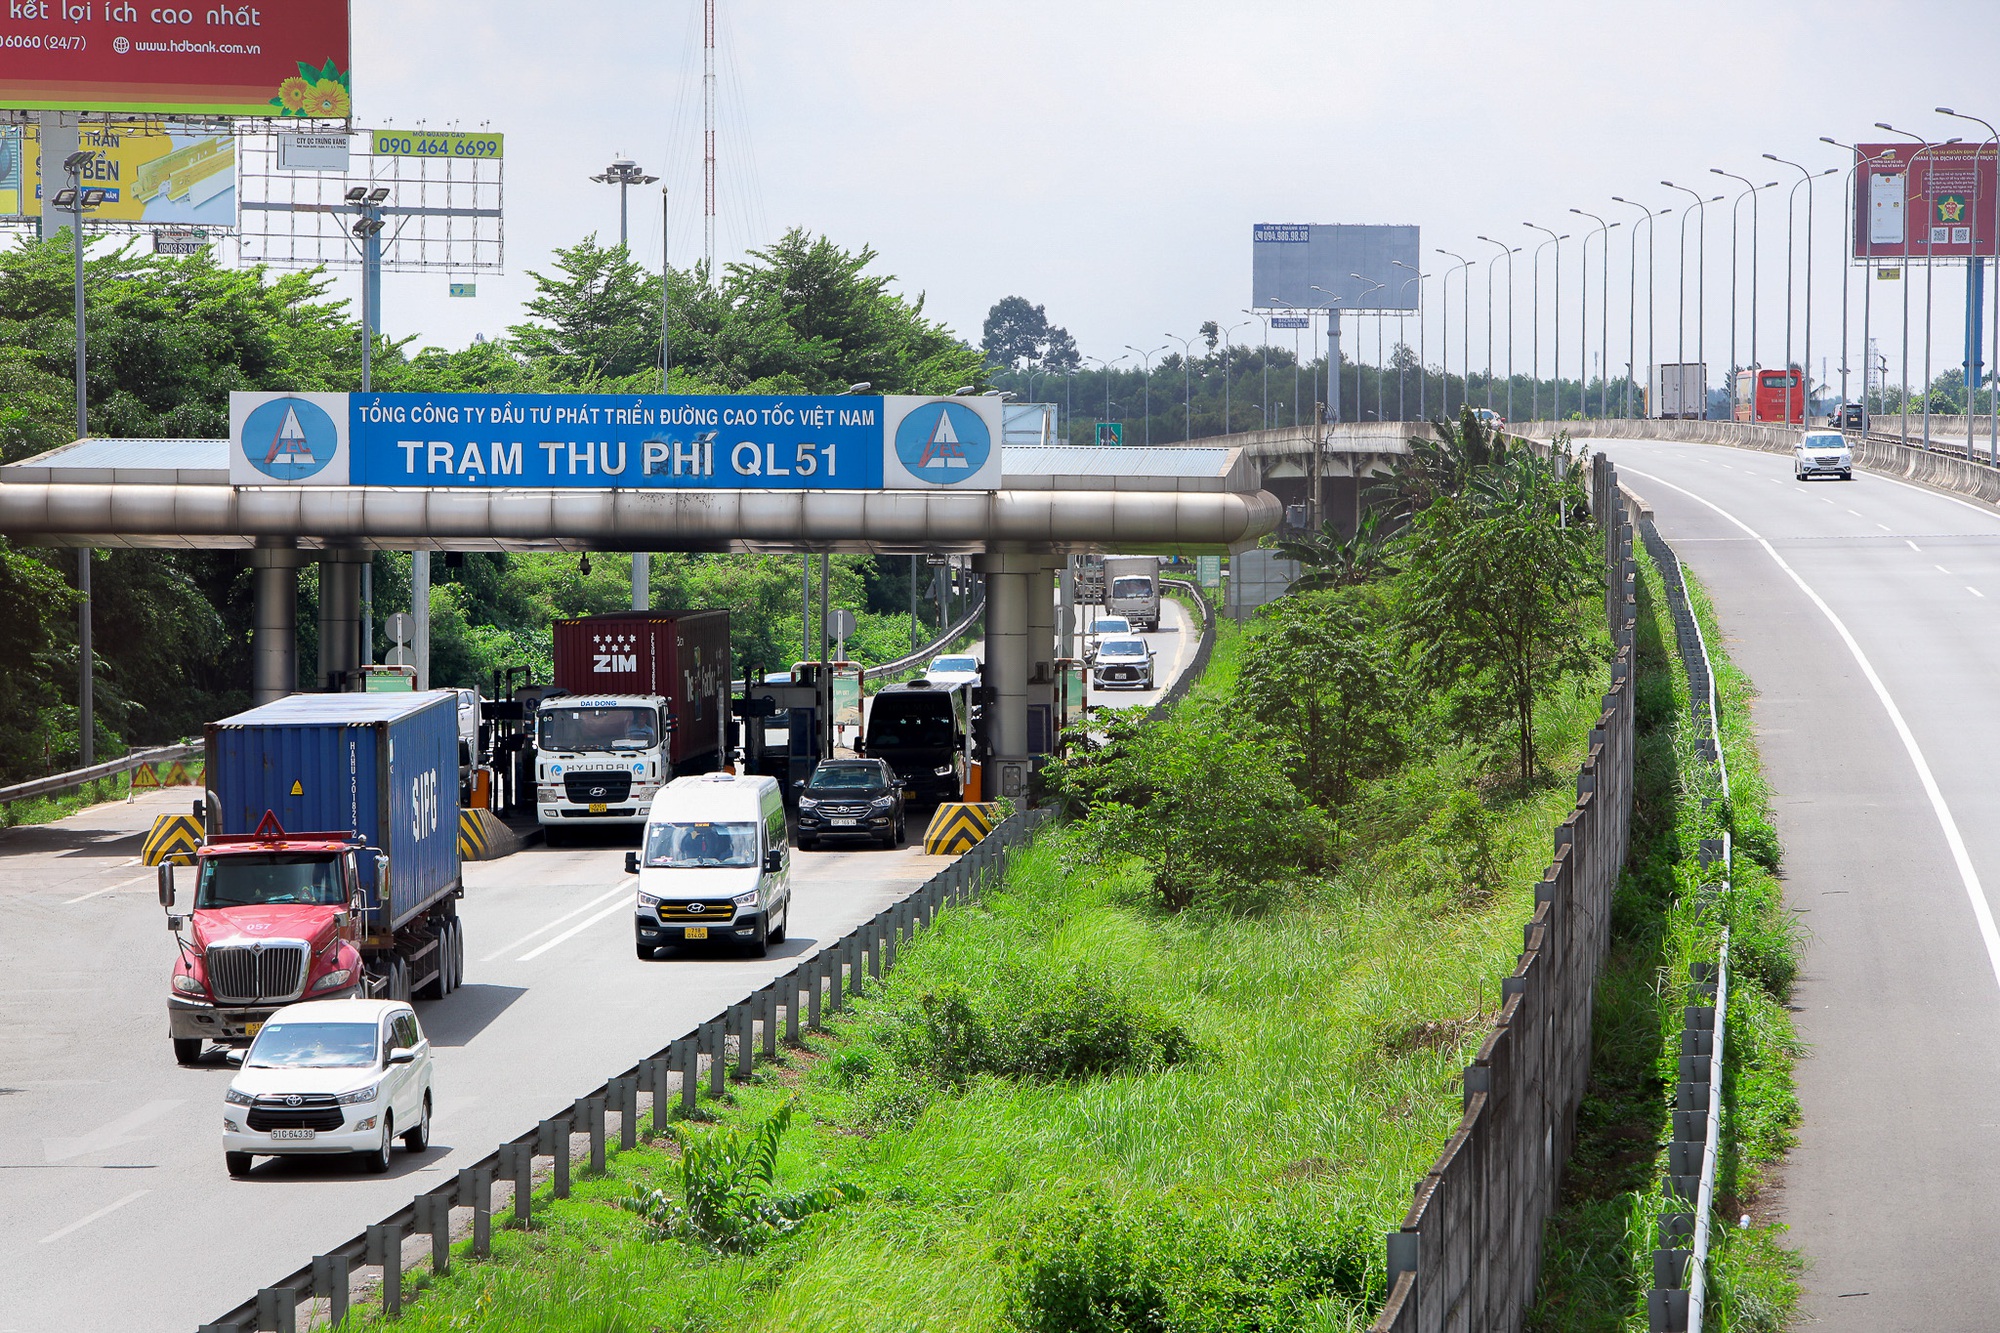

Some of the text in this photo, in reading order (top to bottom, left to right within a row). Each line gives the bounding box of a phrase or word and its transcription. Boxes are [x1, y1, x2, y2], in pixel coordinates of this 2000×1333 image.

[62, 0, 91, 24] lợi
[105, 2, 137, 22] ích
[151, 8, 193, 24] cao
[206, 4, 261, 26] nhất
[135, 39, 261, 54] www.hdbank.com.vn
[379, 137, 497, 156] 090 464 6699
[82, 150, 119, 181] BỀN
[359, 397, 875, 429] TỔNG CÔNG TY ĐẦU TƯ PHÁT TRIỂN ĐƯỜNG CAO TỐC VIỆT NAM
[397, 431, 837, 482] TRẠM THU PHÍ QL51
[593, 654, 637, 673] ZIM
[566, 763, 630, 771] HYUNDAI
[412, 767, 437, 843] SIPG
[246, 922, 271, 931] 057
